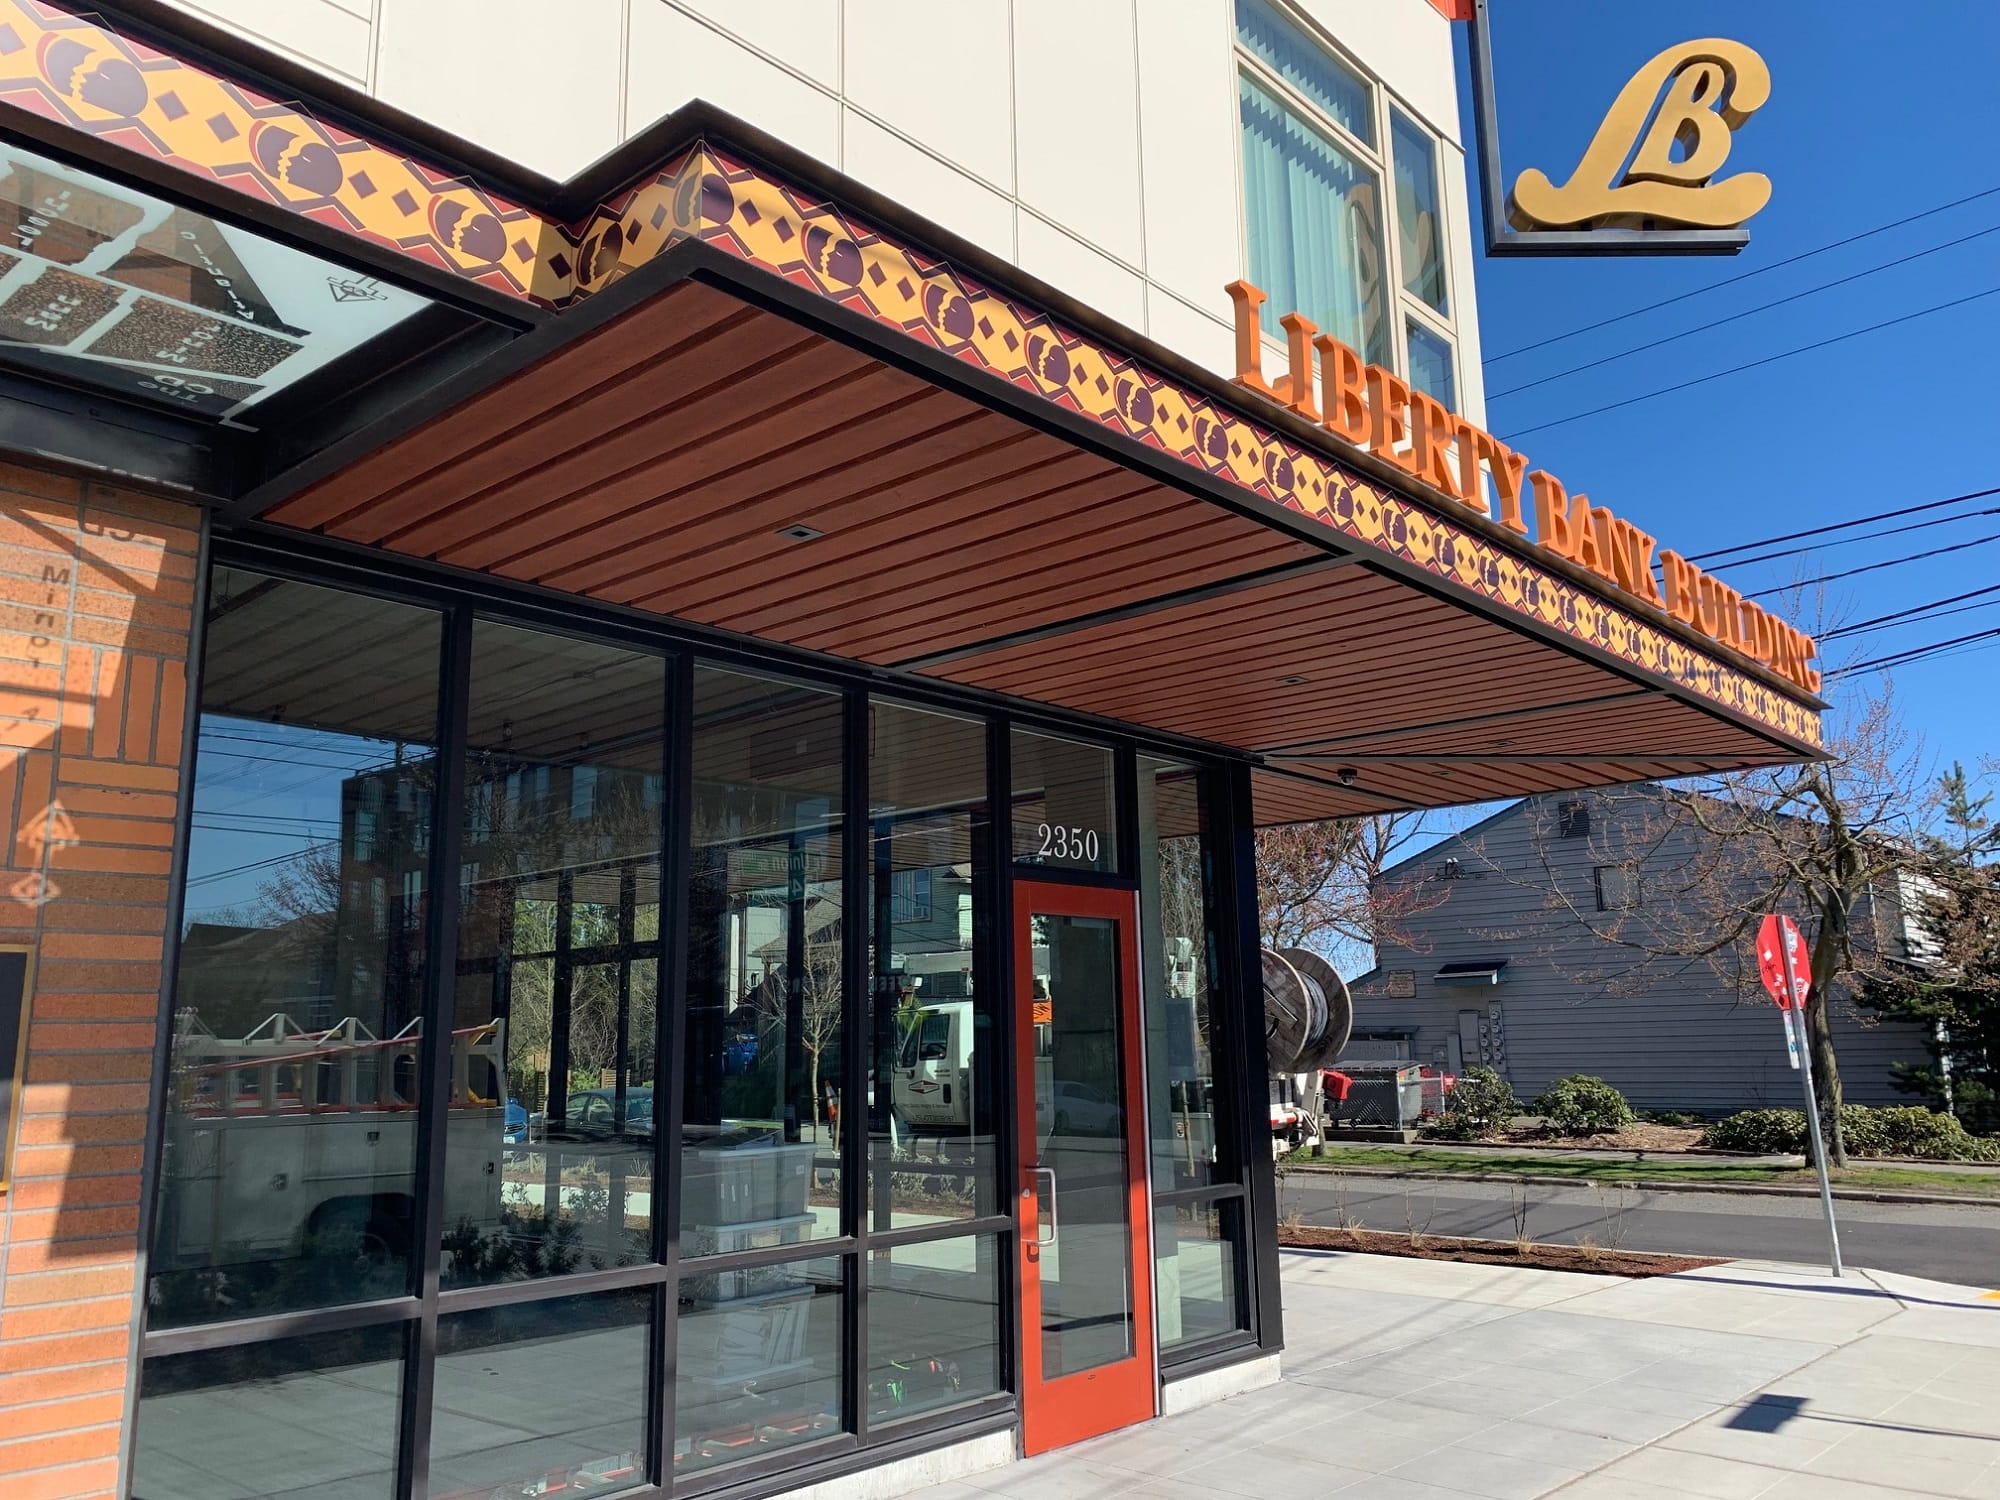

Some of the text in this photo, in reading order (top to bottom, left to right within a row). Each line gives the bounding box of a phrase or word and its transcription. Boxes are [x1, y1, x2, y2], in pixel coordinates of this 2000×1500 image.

[155, 325, 221, 363] Minor
[154, 375, 214, 395] CD
[1224, 279, 1821, 693] LIBERTY BANK BUILDING
[1038, 823, 1099, 862] 2350
